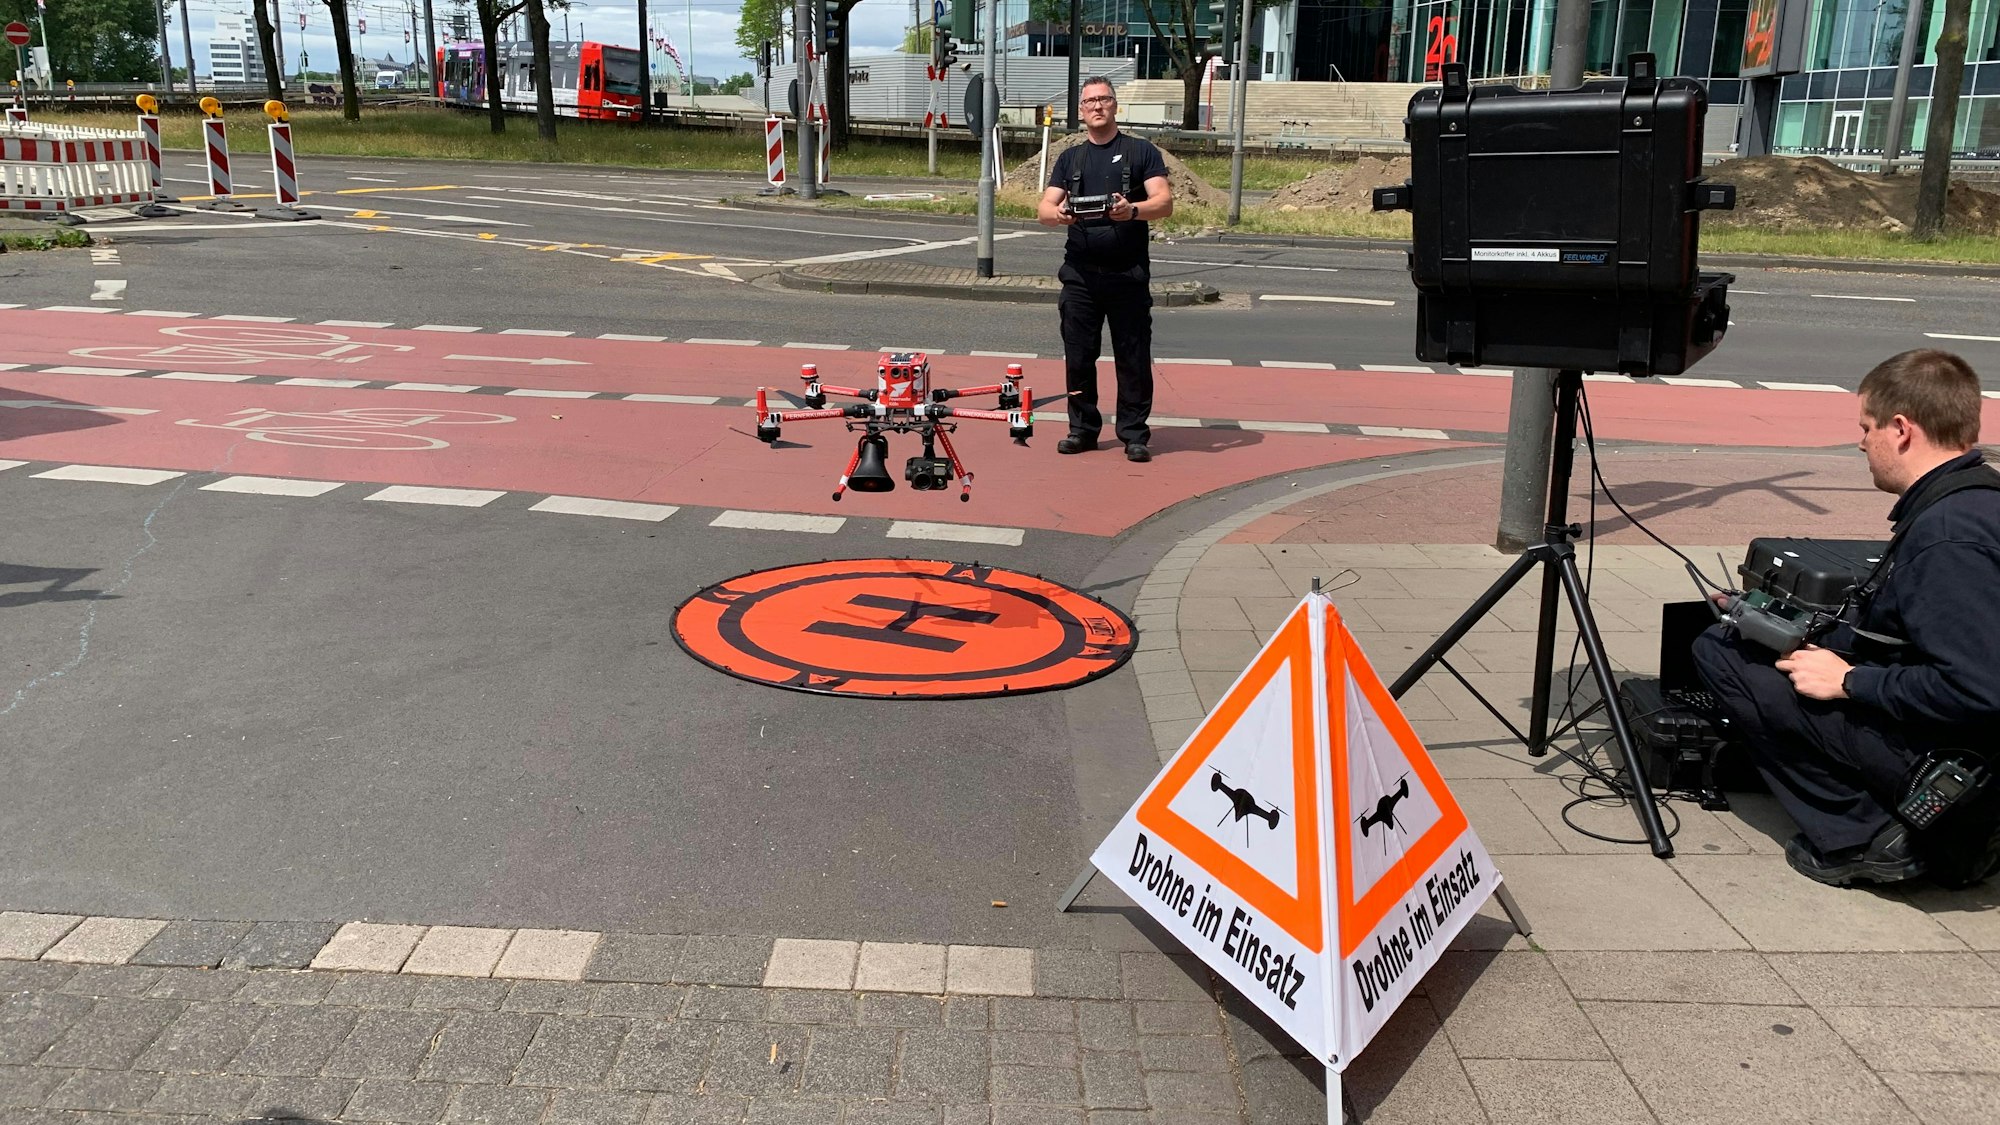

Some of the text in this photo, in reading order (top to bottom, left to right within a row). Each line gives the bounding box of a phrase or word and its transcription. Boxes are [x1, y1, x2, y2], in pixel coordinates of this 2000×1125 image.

[1563, 253, 1605, 261] FEELWORLD
[785, 410, 840, 420] FERNERKUNDUNG
[956, 411, 1006, 419] FERNERKUNDUNG
[801, 593, 1000, 653] H
[1128, 832, 1306, 1011] Drohne im Einsatz
[1352, 848, 1480, 1013] Drohne im Einsatz
